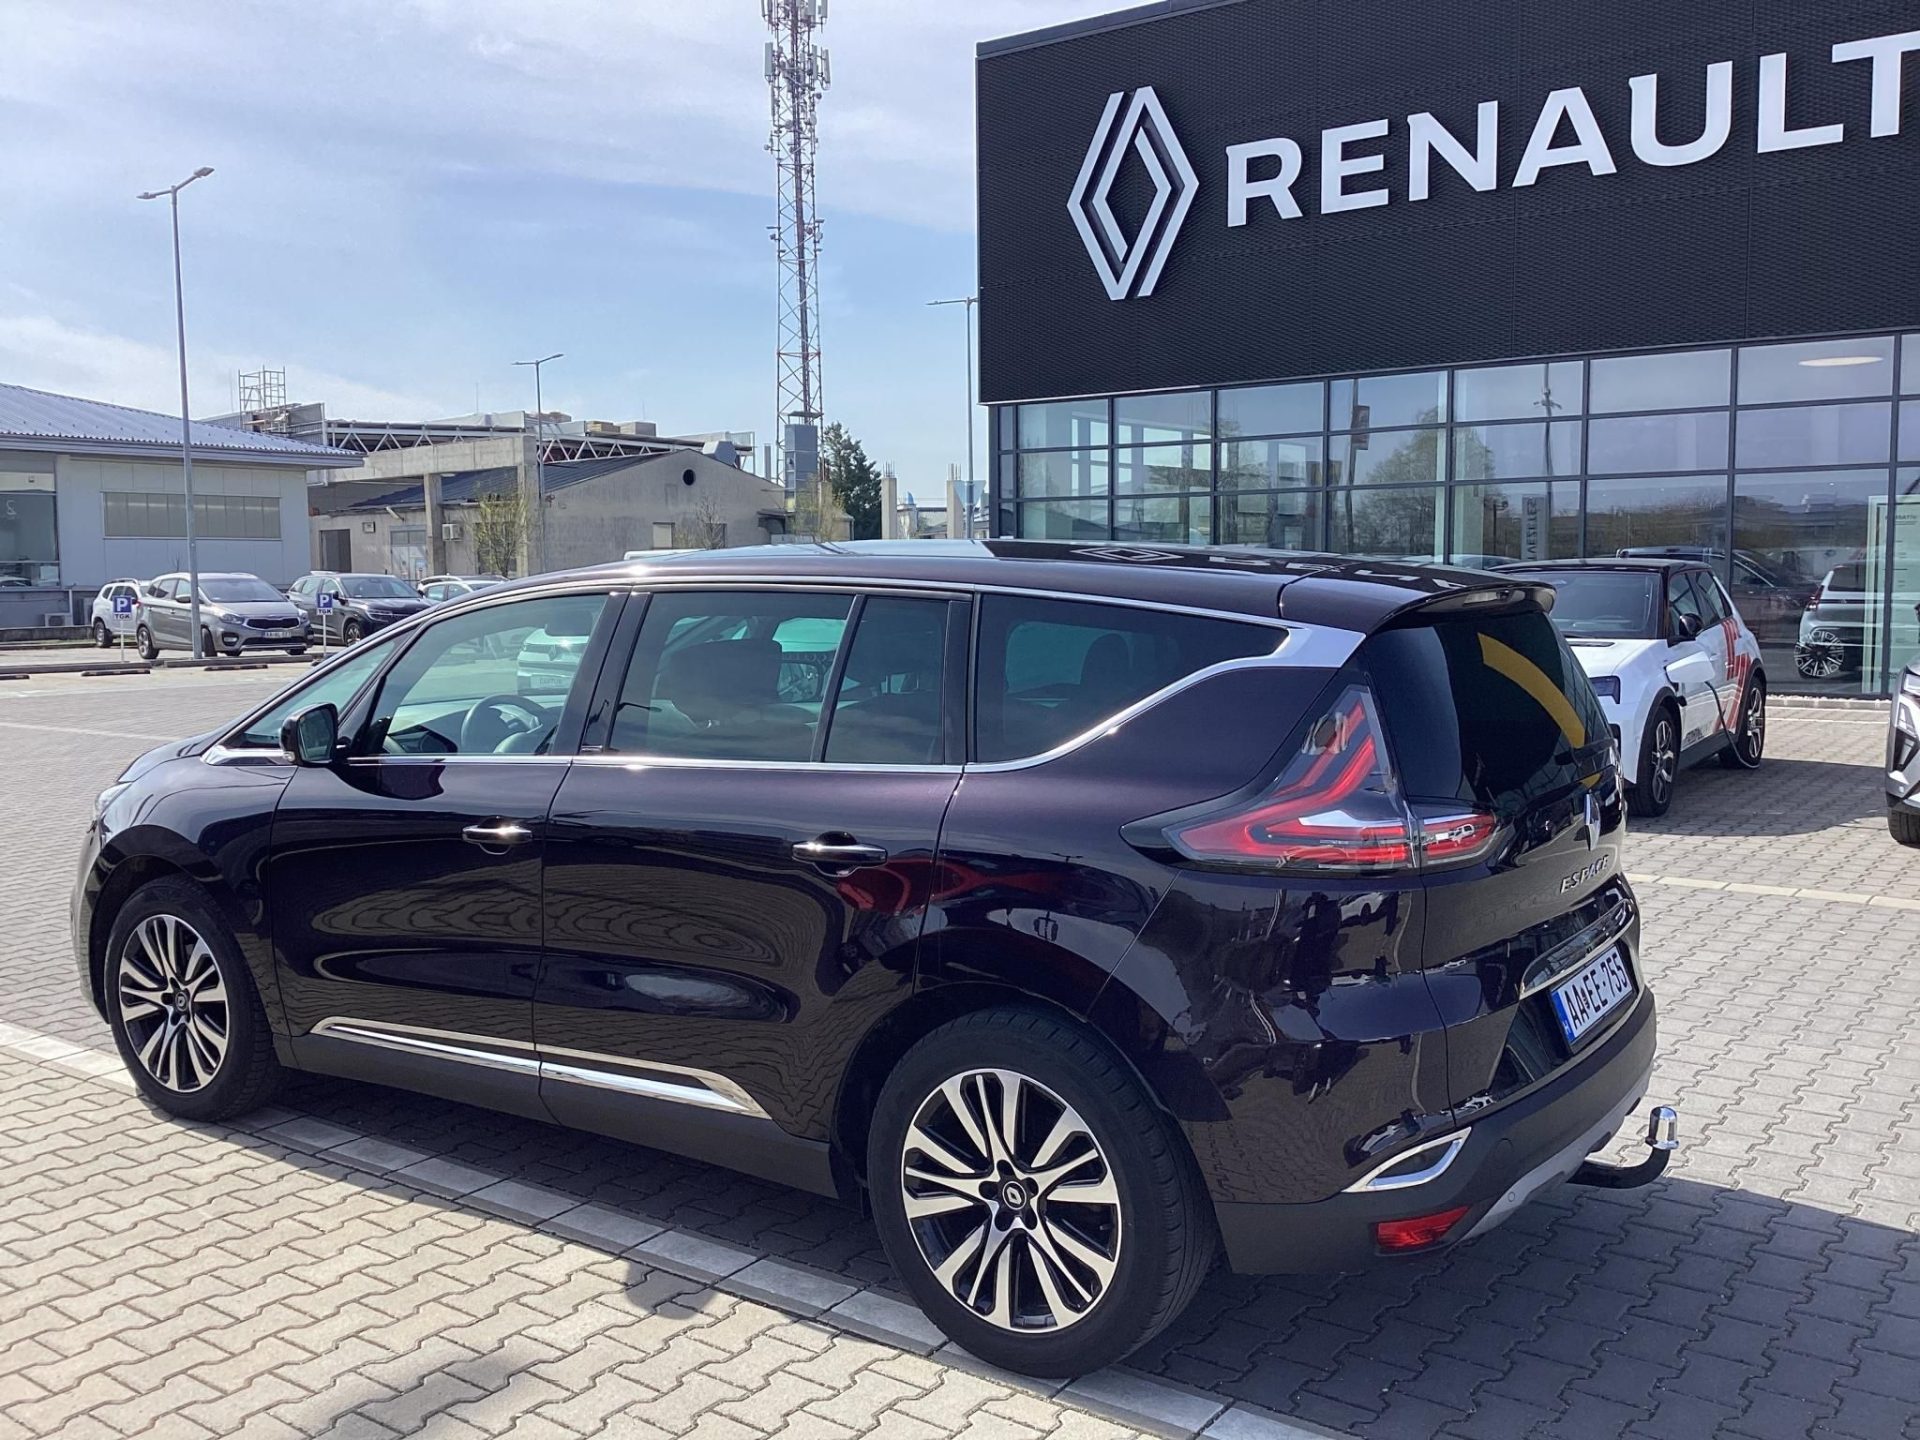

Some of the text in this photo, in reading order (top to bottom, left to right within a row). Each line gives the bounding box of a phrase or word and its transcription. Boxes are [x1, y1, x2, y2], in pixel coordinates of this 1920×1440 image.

[1226, 30, 1920, 228] RENAULT
[116, 597, 128, 612] P
[320, 594, 330, 607] P
[1560, 854, 1609, 894] ESPACE
